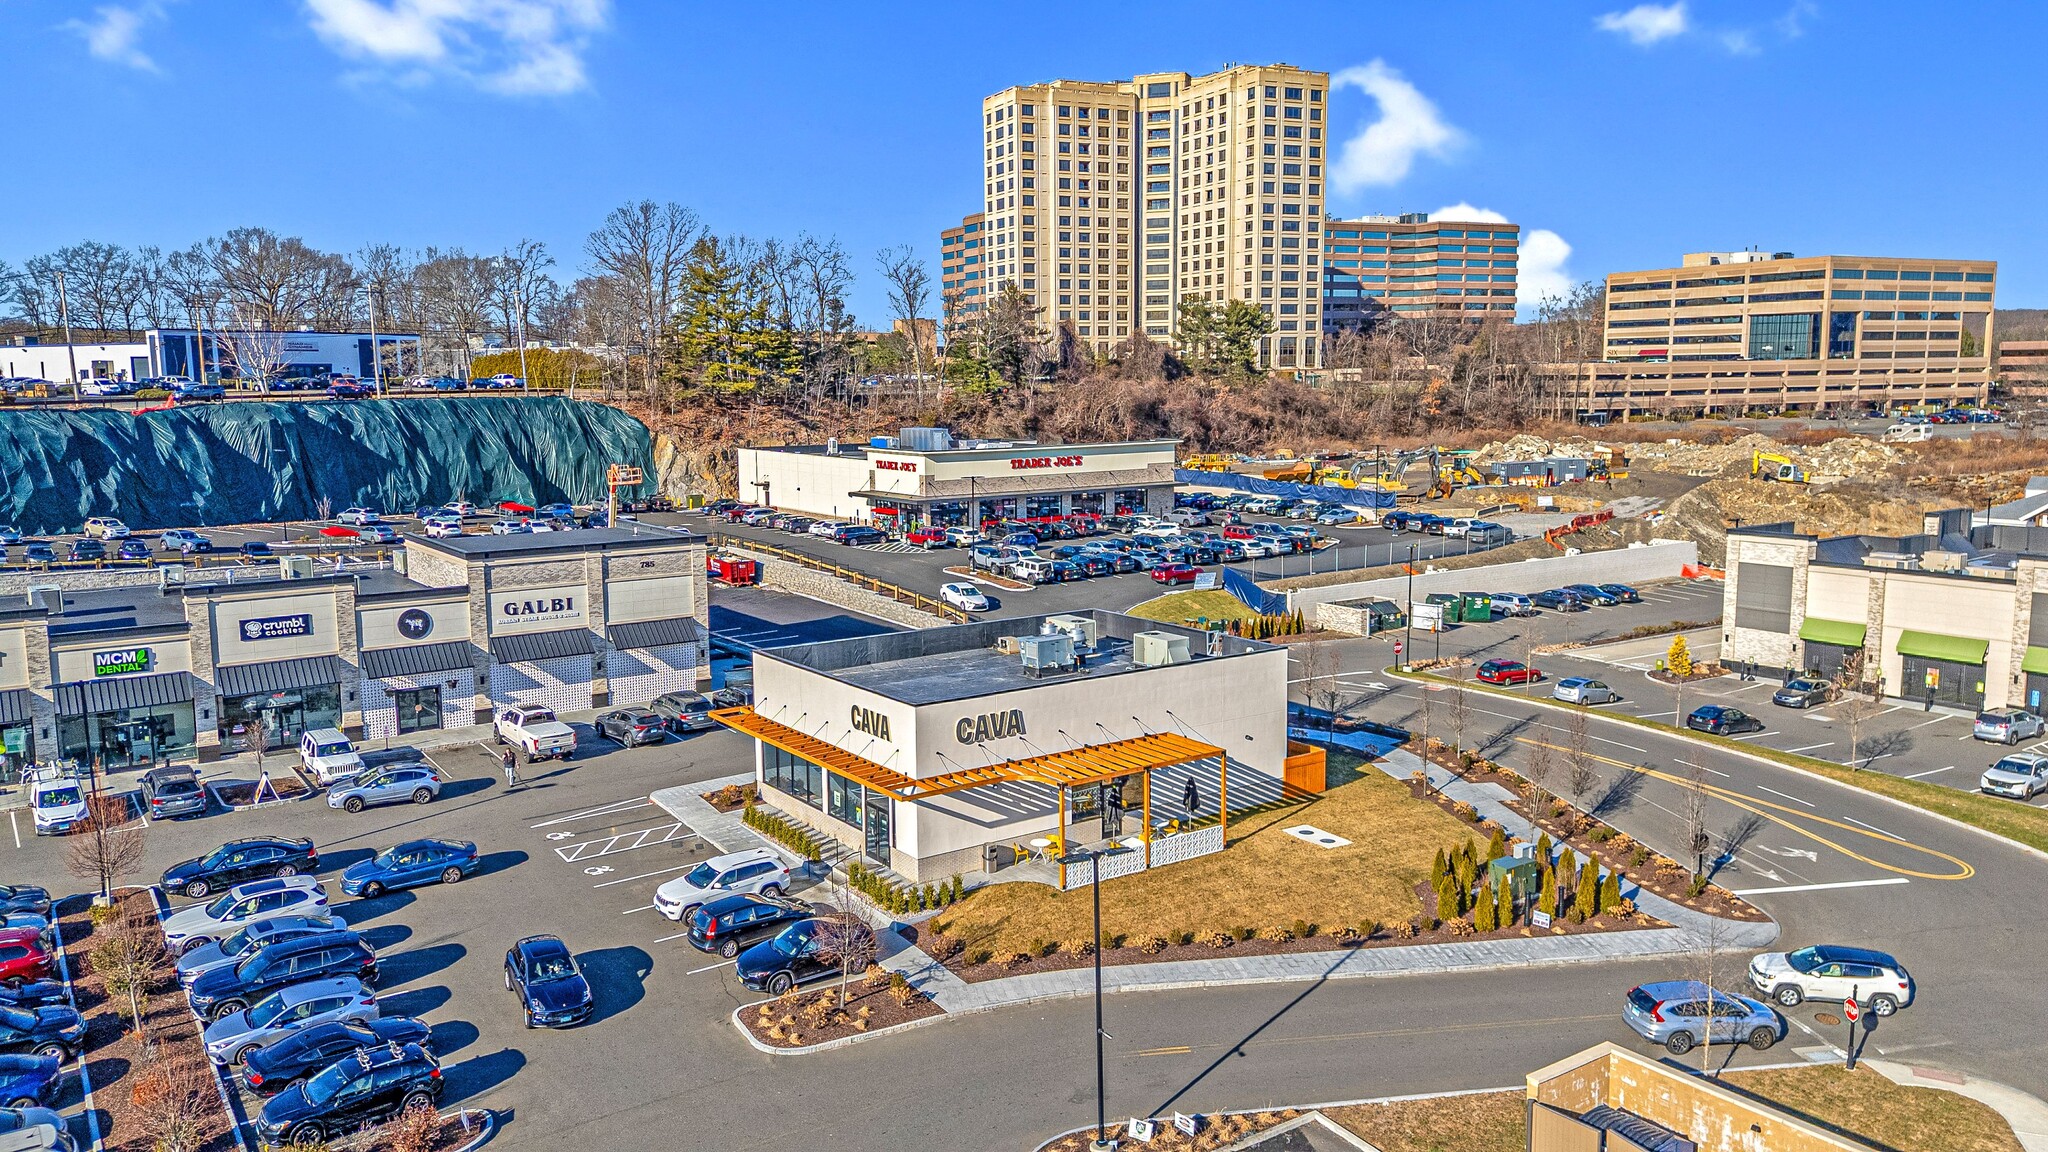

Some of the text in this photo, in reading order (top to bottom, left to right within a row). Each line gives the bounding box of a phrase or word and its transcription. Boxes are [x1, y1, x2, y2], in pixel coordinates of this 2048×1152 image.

[876, 460, 917, 472] TRADER JOE'S
[1010, 455, 1083, 469] TRADER JOE'S
[503, 597, 574, 615] GALBI
[263, 617, 305, 630] crumbl
[265, 627, 304, 636] cookies
[96, 651, 136, 665] MCM
[97, 663, 142, 674] DENTAL
[851, 704, 892, 743] CAVA
[956, 709, 1027, 745] CAVA
[1845, 1003, 1858, 1016] STOP
